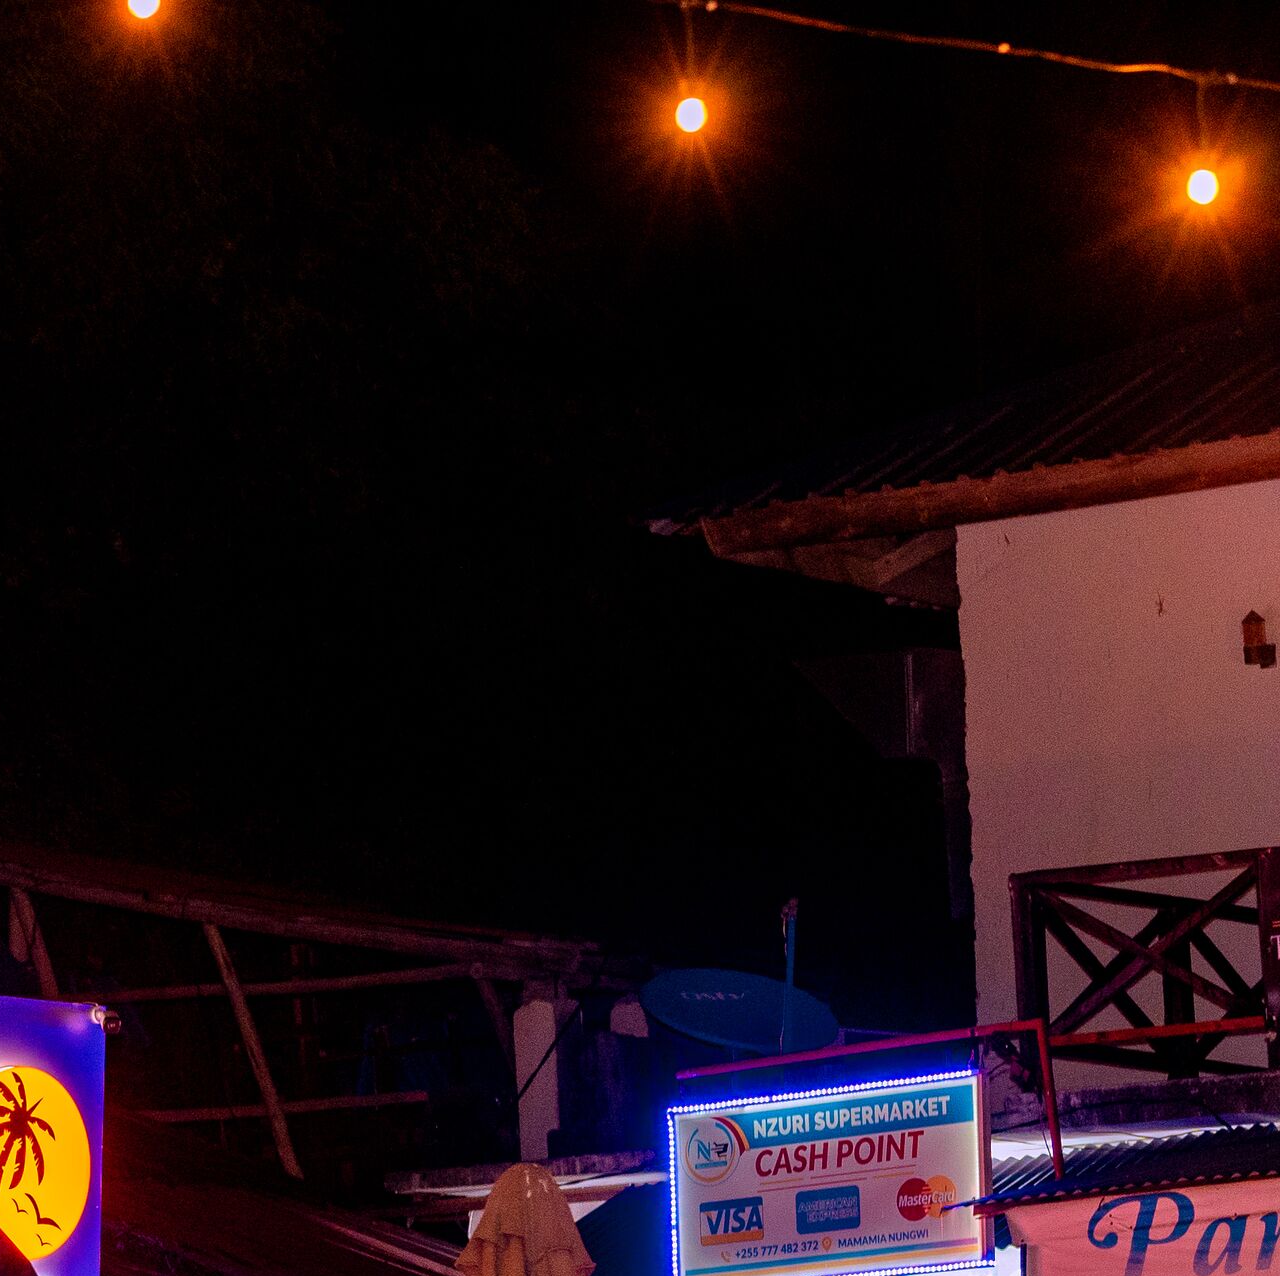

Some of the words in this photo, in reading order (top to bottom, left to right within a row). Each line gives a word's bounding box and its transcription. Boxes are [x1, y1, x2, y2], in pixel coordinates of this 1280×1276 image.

[753, 1115, 810, 1139] NZURI
[814, 1096, 950, 1131] SUPERMARKET
[755, 1141, 829, 1177] CASH
[836, 1130, 924, 1167] POINT
[898, 1189, 955, 1208] MasterCard
[705, 1204, 763, 1235] VISA
[735, 1247, 758, 1259] +255
[760, 1245, 778, 1257] 777
[780, 1243, 799, 1255] 482
[800, 1241, 819, 1253] 372
[837, 1233, 887, 1249] MAMAMIA
[889, 1229, 929, 1244] NUNGWI
